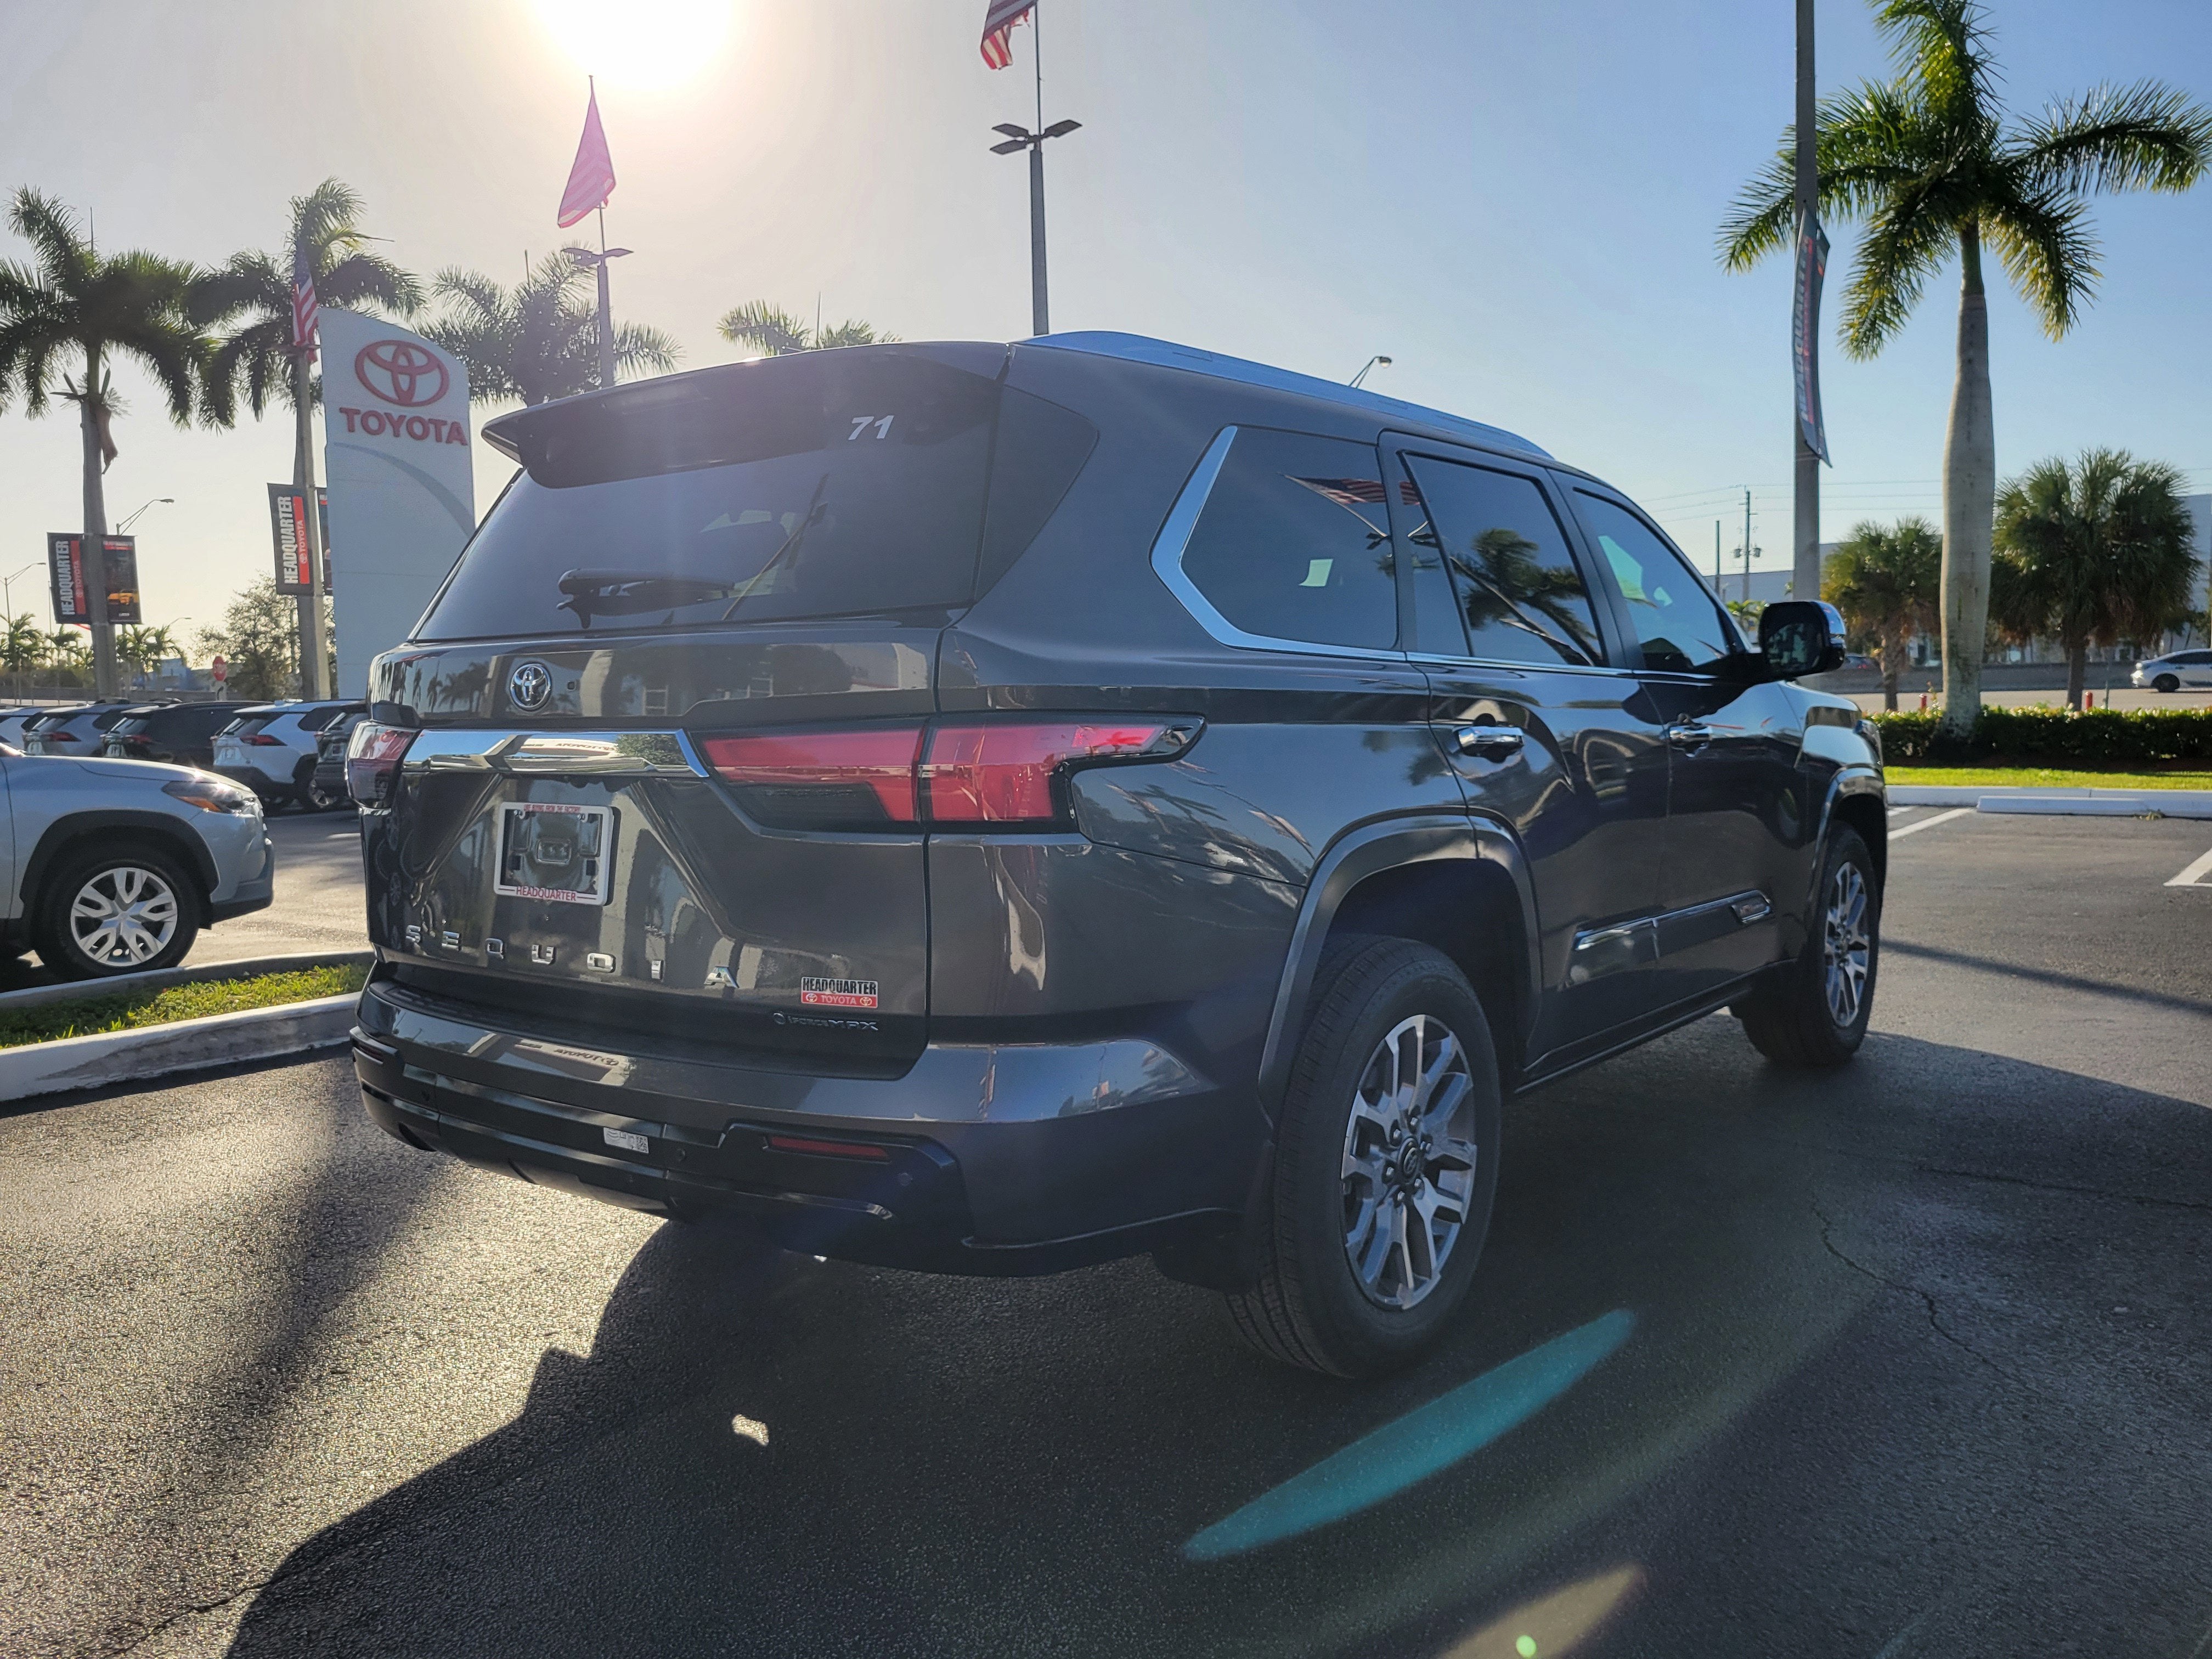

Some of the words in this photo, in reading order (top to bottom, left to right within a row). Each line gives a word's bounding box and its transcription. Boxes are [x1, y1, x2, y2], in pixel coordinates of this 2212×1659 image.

[339, 407, 468, 446] TOYOTA
[849, 415, 894, 440] 71
[278, 496, 298, 584] HEADQUARTER
[297, 520, 306, 551] TOYOTA
[56, 540, 75, 615] HEADQUARTER
[74, 561, 82, 588] TOYOTA
[516, 887, 577, 901] HEADQUARTER
[405, 924, 738, 988] SEQUOIA
[803, 978, 877, 995] HEADQUARTER
[821, 995, 857, 1005] TOYOTA
